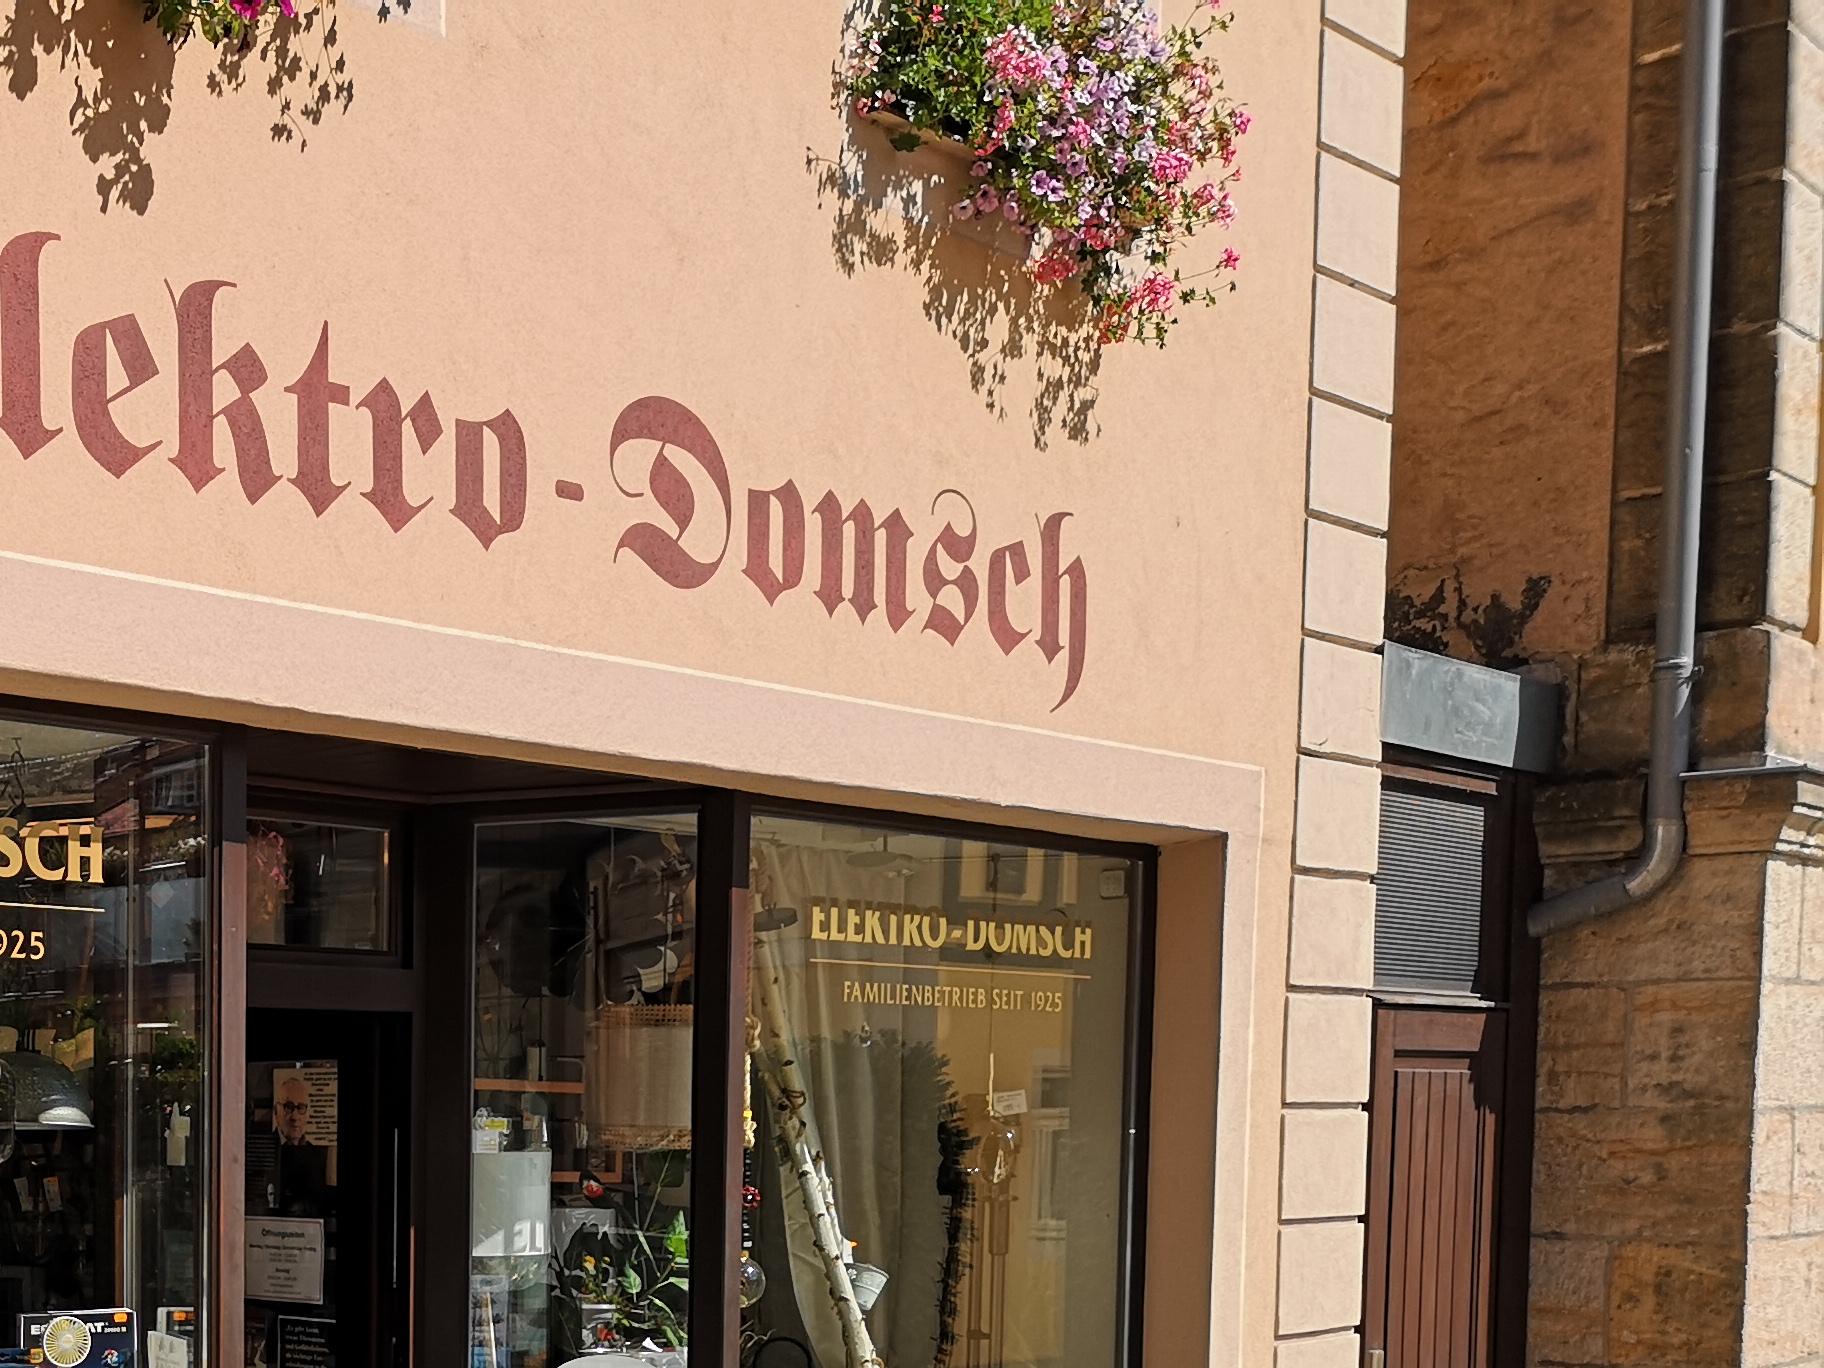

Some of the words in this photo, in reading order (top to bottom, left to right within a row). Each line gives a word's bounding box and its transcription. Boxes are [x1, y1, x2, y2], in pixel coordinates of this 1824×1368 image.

[842, 981, 987, 1009] FAMILIENBETRIEB
[991, 988, 1024, 1011] SEIT
[1030, 991, 1063, 1013] 1925
